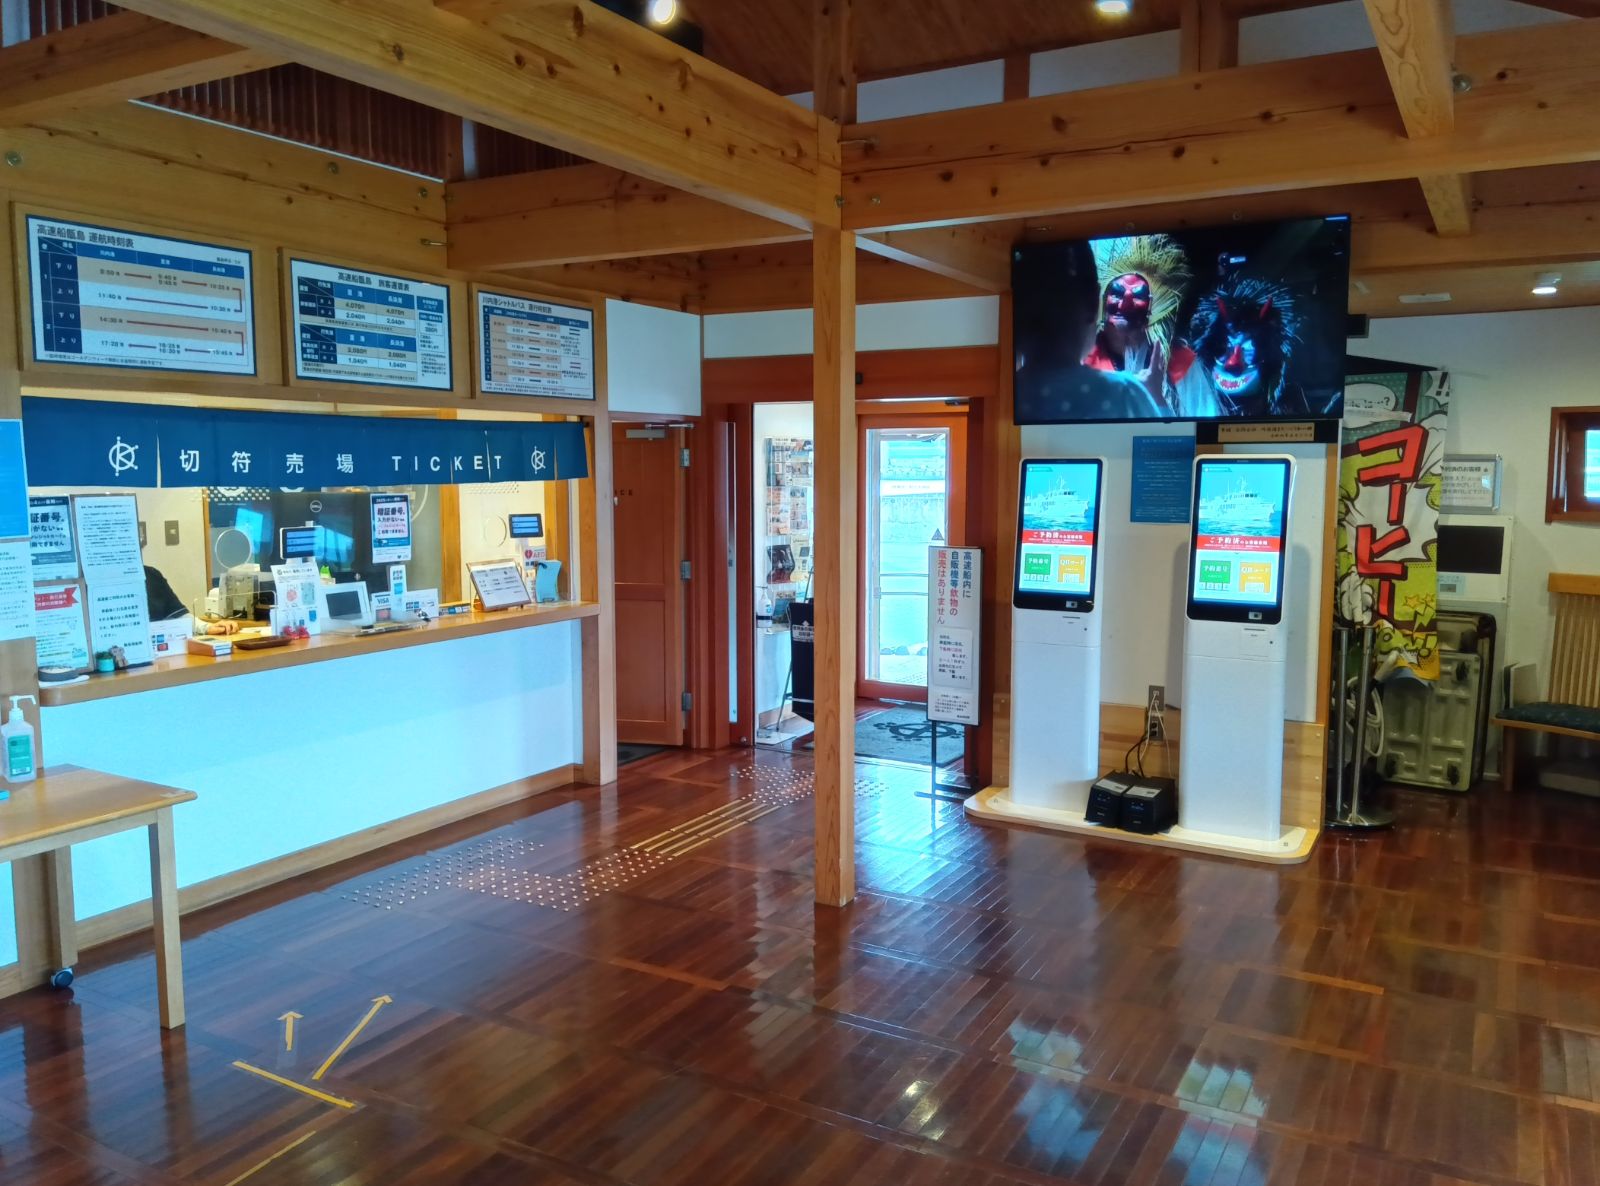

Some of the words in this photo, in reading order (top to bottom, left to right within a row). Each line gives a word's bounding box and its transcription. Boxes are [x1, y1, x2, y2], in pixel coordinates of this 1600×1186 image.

[37, 224, 86, 241] 高速船甑島
[88, 231, 135, 249] 運航時刻表
[178, 450, 354, 477] 切符売場
[391, 455, 502, 474] TICKET
[936, 549, 948, 625] 販売はありません
[949, 550, 960, 617] 自販機等飲物の
[962, 551, 974, 599] 高速船内に
